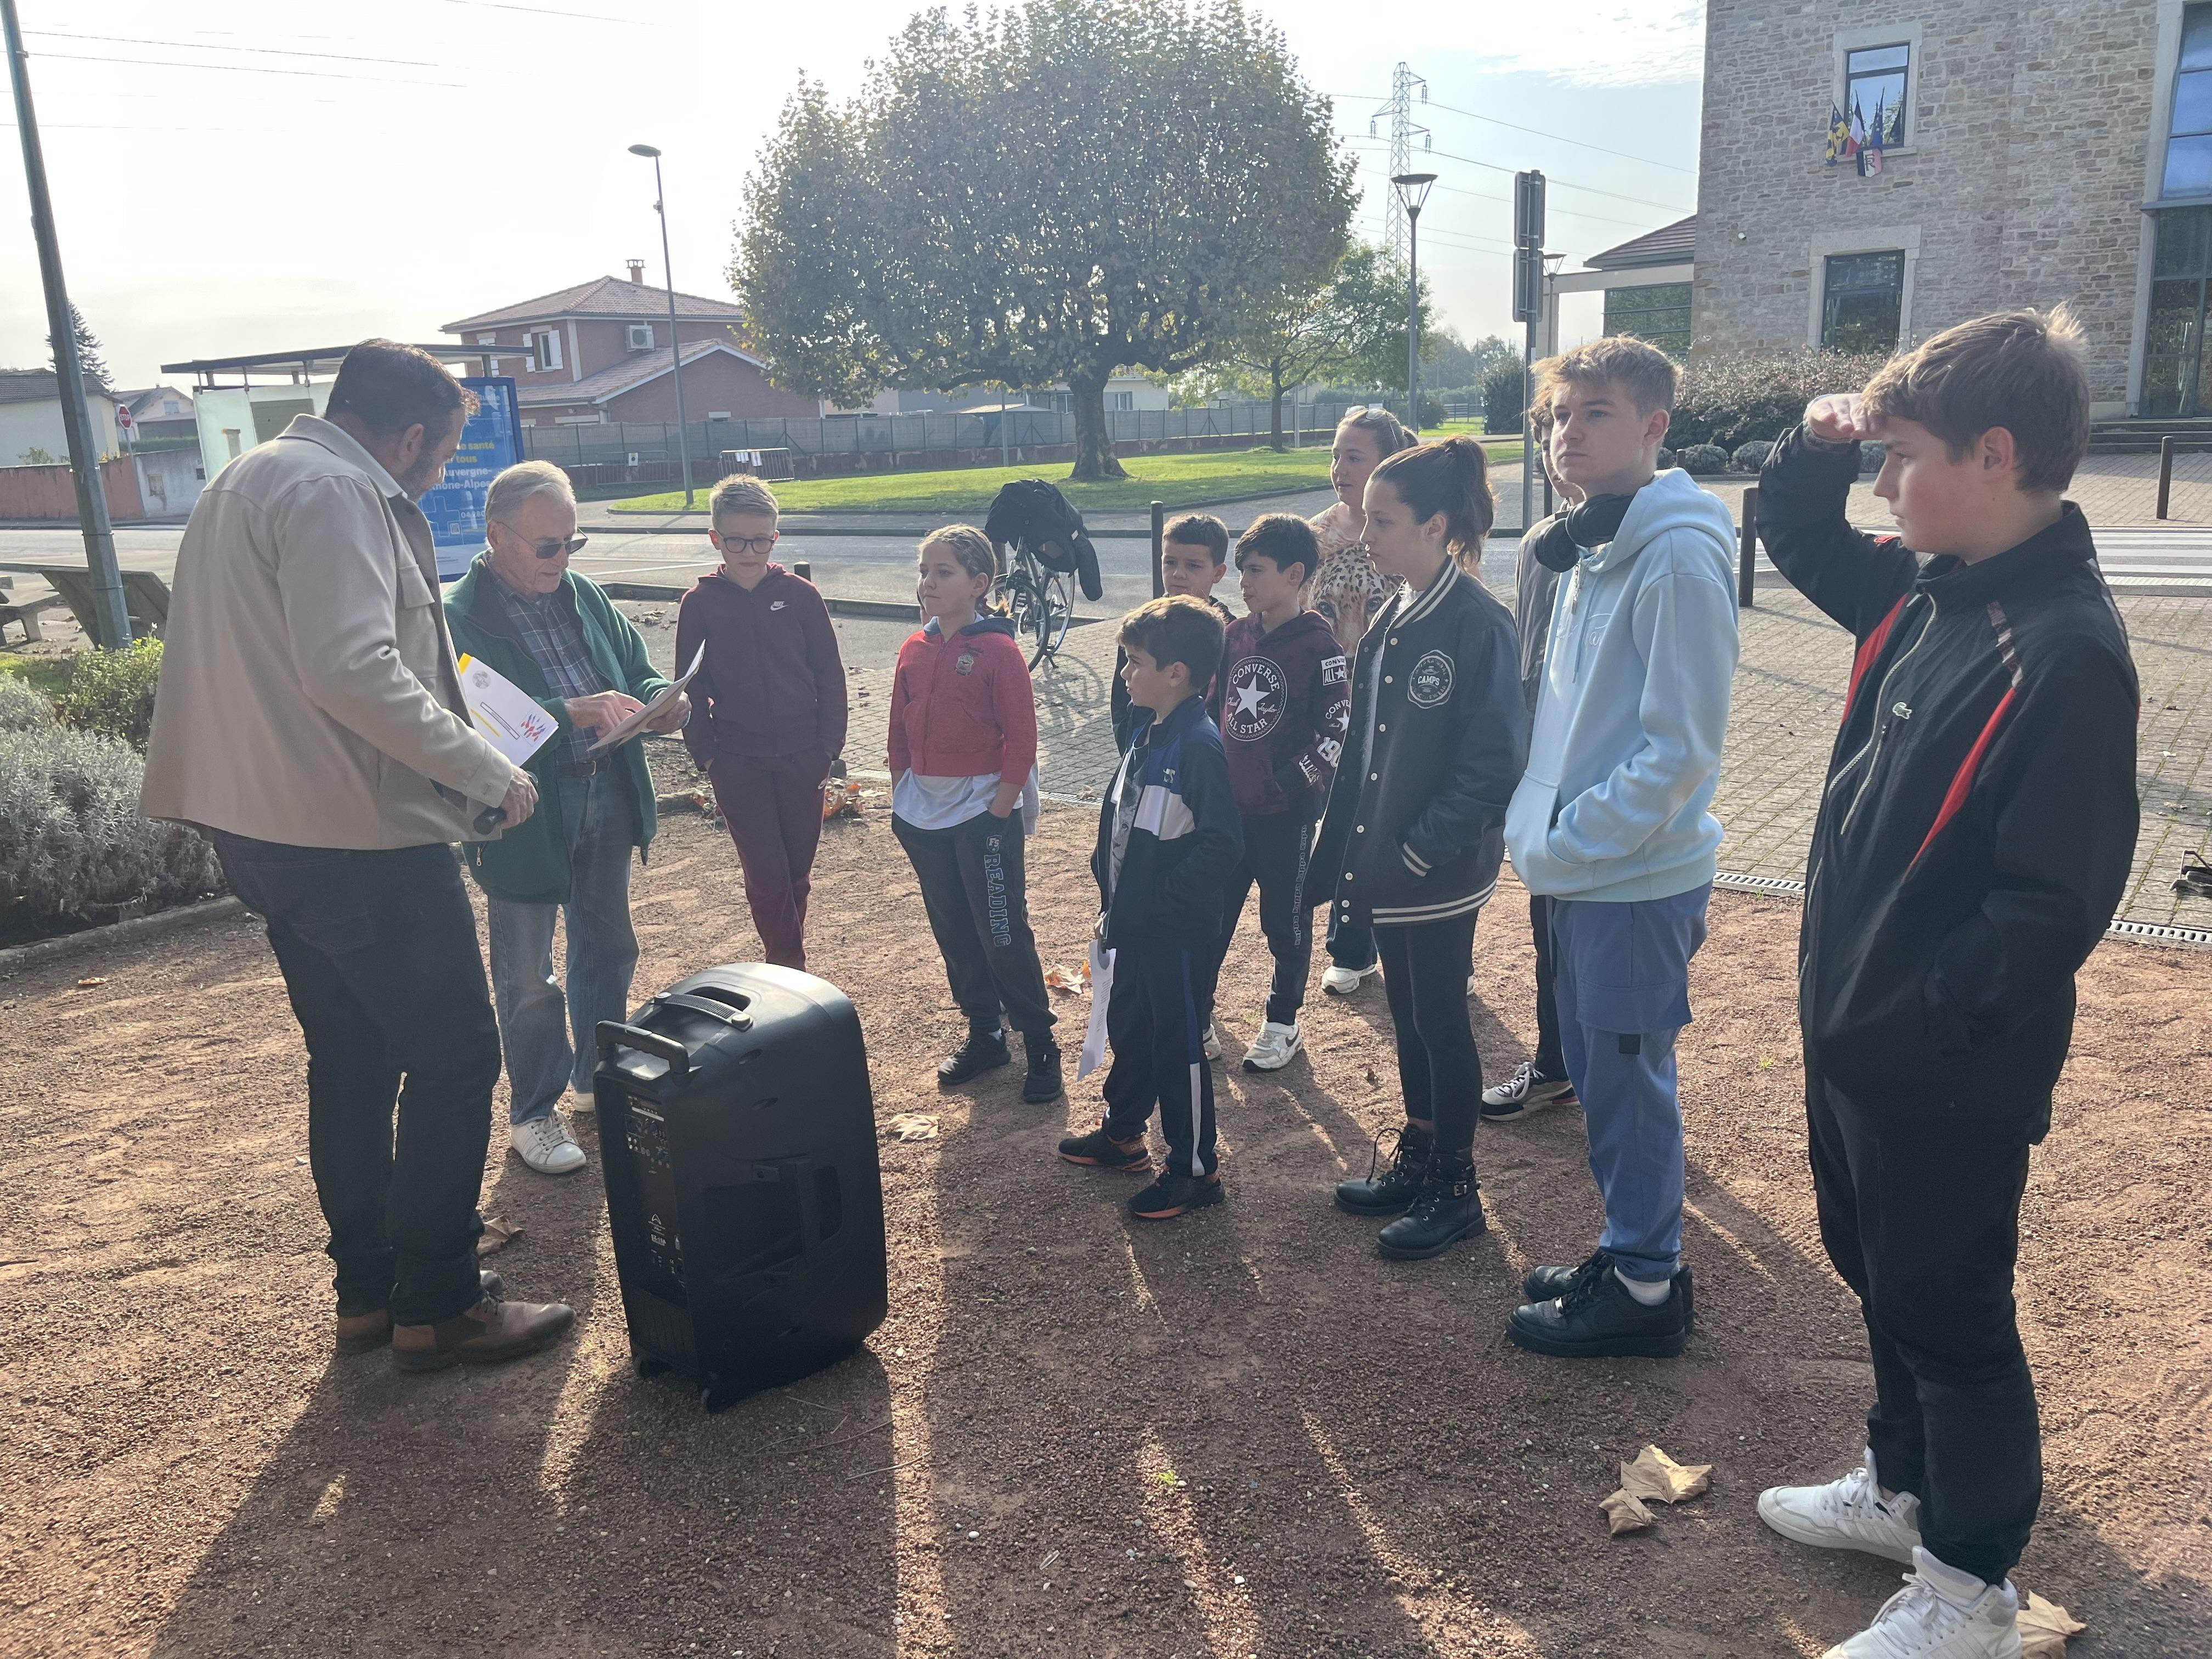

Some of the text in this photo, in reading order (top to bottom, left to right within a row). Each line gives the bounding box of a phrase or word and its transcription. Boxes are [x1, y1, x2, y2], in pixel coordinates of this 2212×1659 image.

[468, 441, 495, 450] santé
[1232, 663, 1280, 691] CONVERSE
[1324, 668, 1336, 684] ALL
[1418, 675, 1440, 686] CAMPS
[1257, 702, 1278, 715] Taylor
[1227, 712, 1268, 734] ALL STAR
[984, 853, 1012, 947] READING
